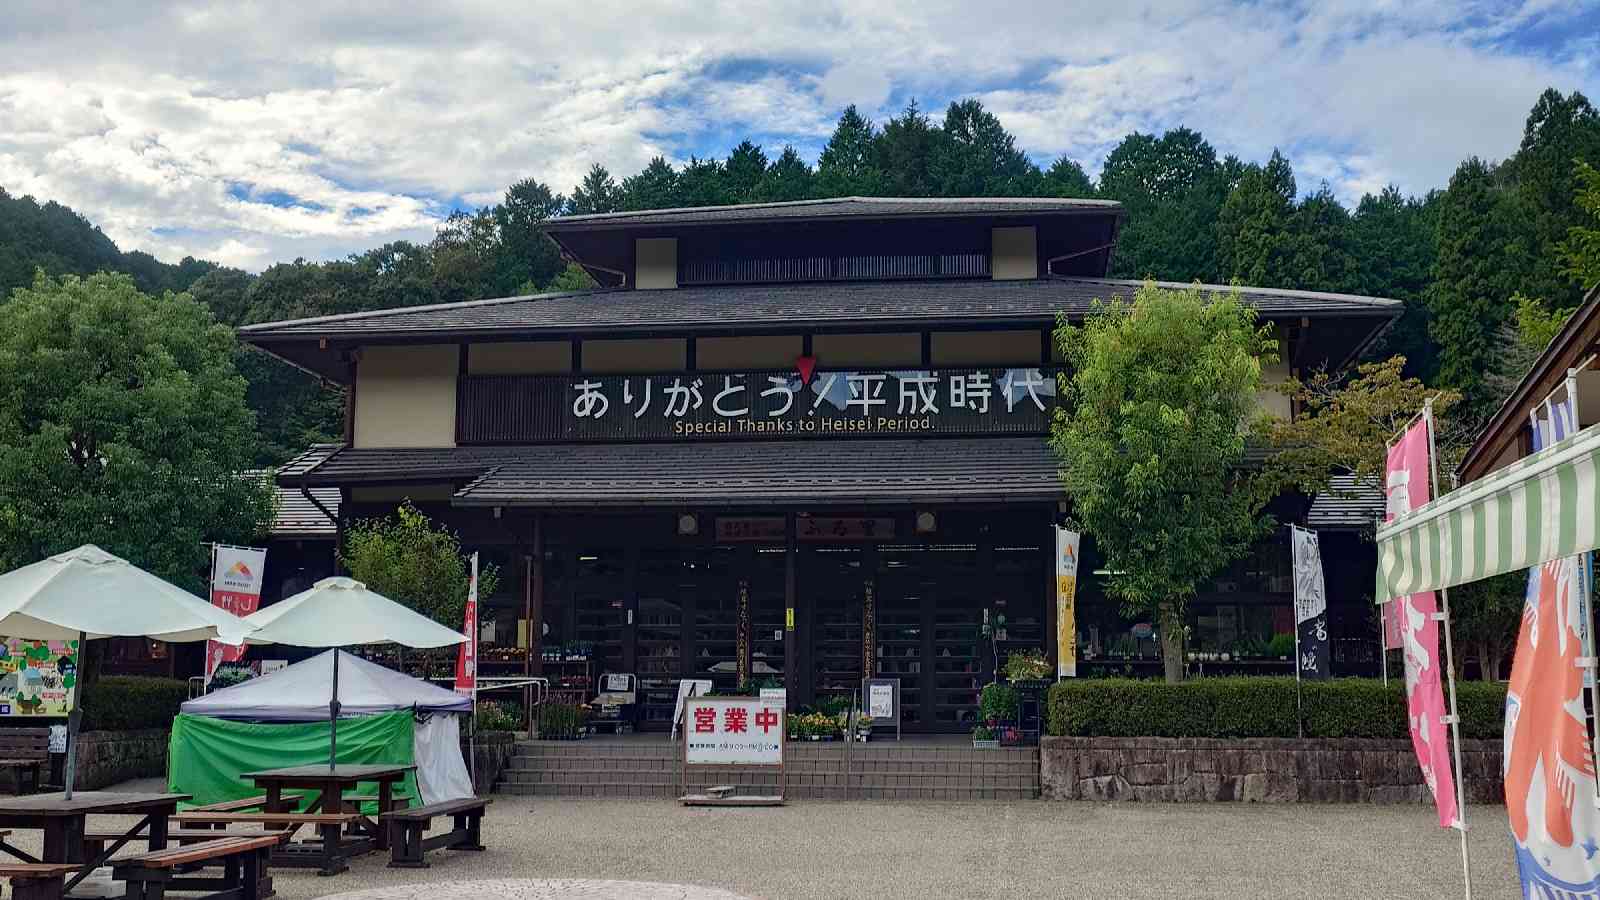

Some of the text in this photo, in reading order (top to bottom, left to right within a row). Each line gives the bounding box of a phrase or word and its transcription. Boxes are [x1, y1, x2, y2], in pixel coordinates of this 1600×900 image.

[675, 416, 935, 436] Special Thanks to Heisei Period.
[694, 707, 778, 734] 営業中
